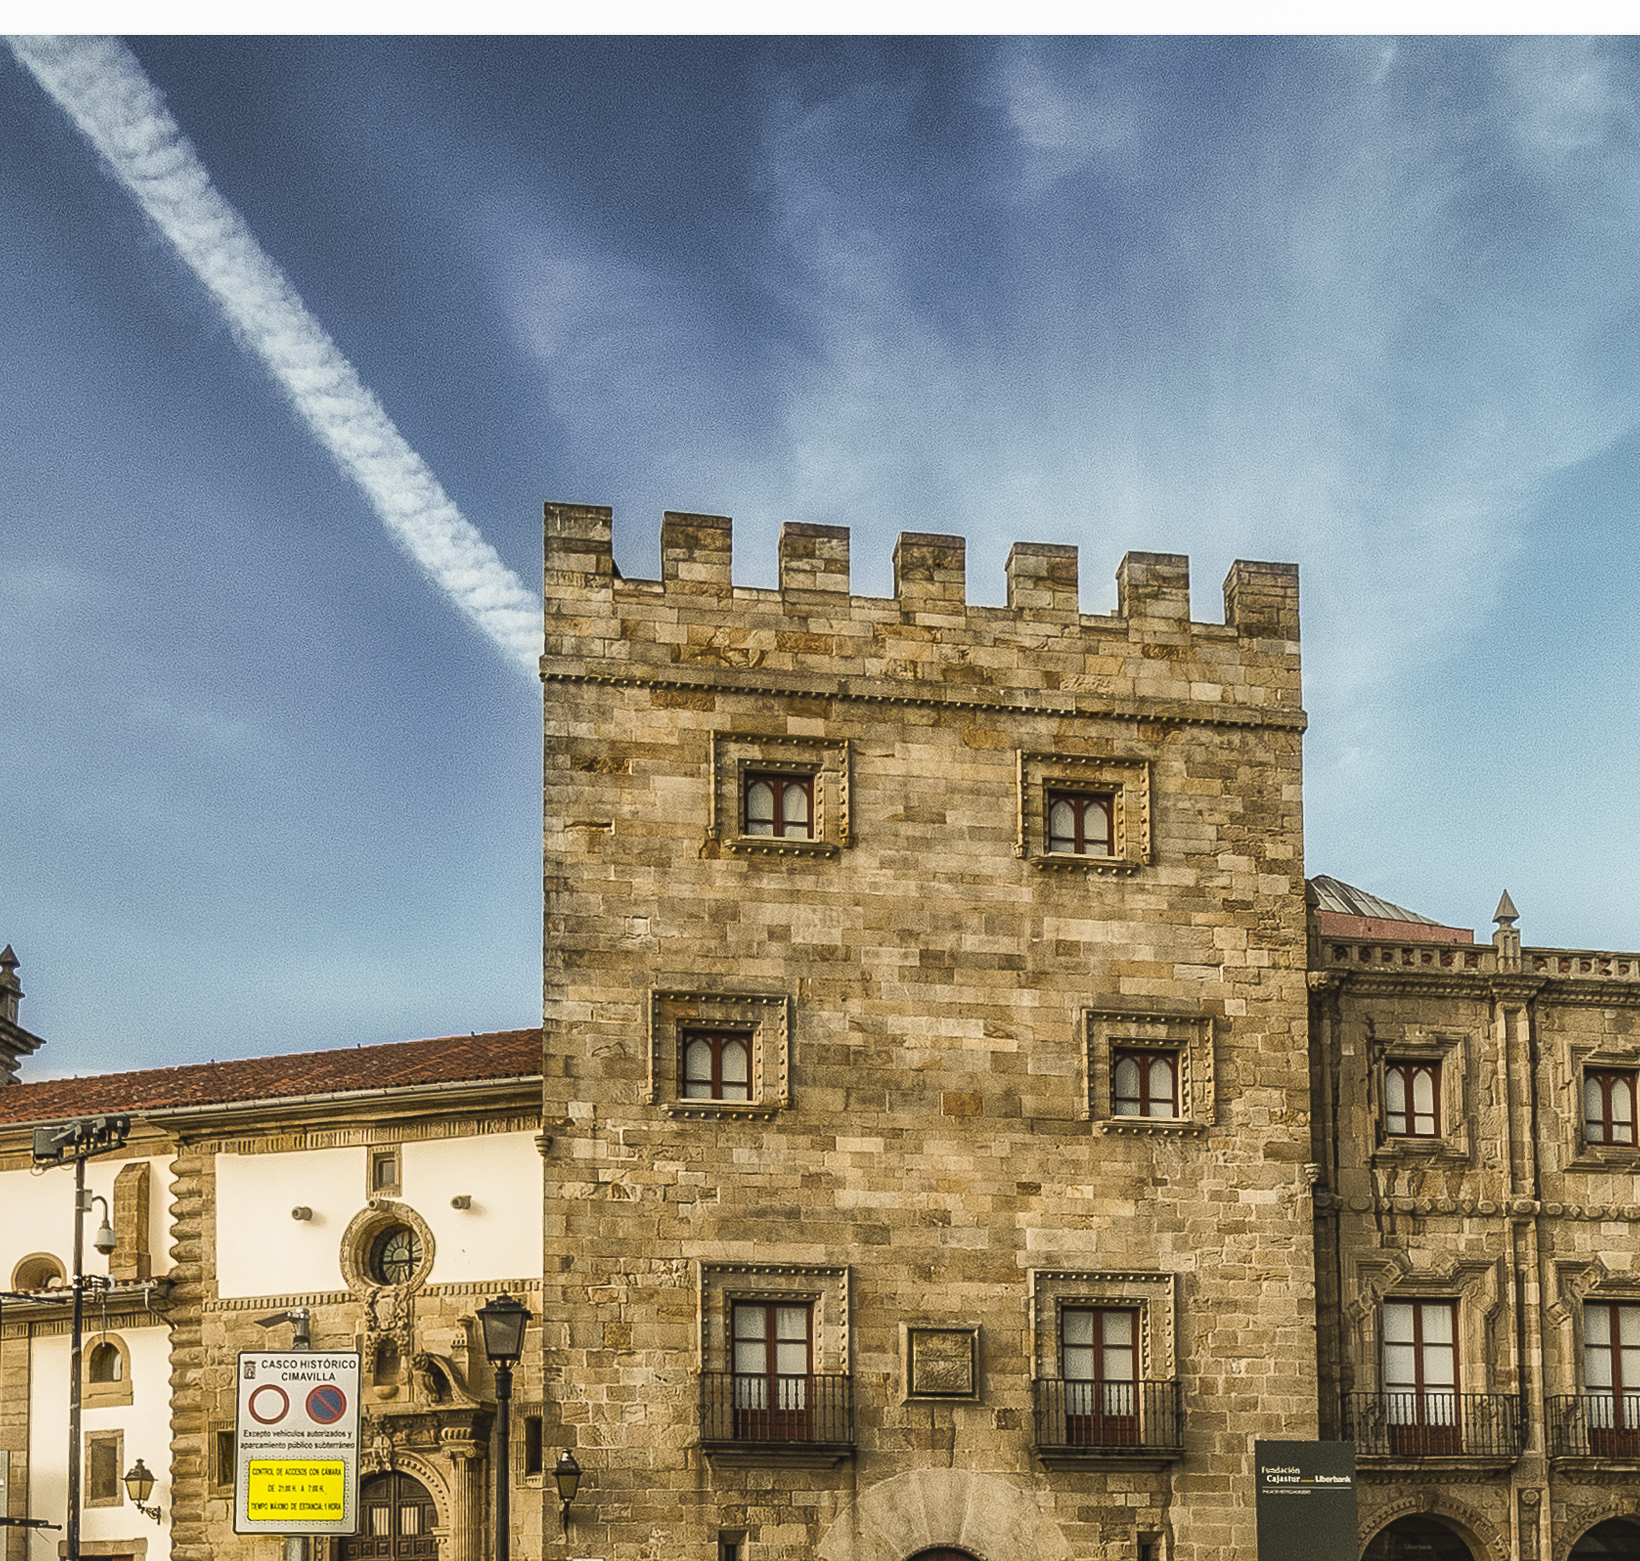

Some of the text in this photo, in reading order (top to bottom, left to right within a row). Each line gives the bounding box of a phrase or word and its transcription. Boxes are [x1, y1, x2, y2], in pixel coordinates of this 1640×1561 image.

[261, 1358, 357, 1369] CASCO HISTÓRICO
[281, 1372, 336, 1382] CIMAVILLA
[243, 1429, 271, 1439] Excepto
[306, 1429, 347, 1438] autorizados
[240, 1441, 287, 1450] aparcamiento
[252, 1467, 275, 1476] CONTROL
[276, 1467, 283, 1476] DE
[1261, 1466, 1301, 1474] Fundación
[1266, 1474, 1352, 1484] Cajastur Liberbank
